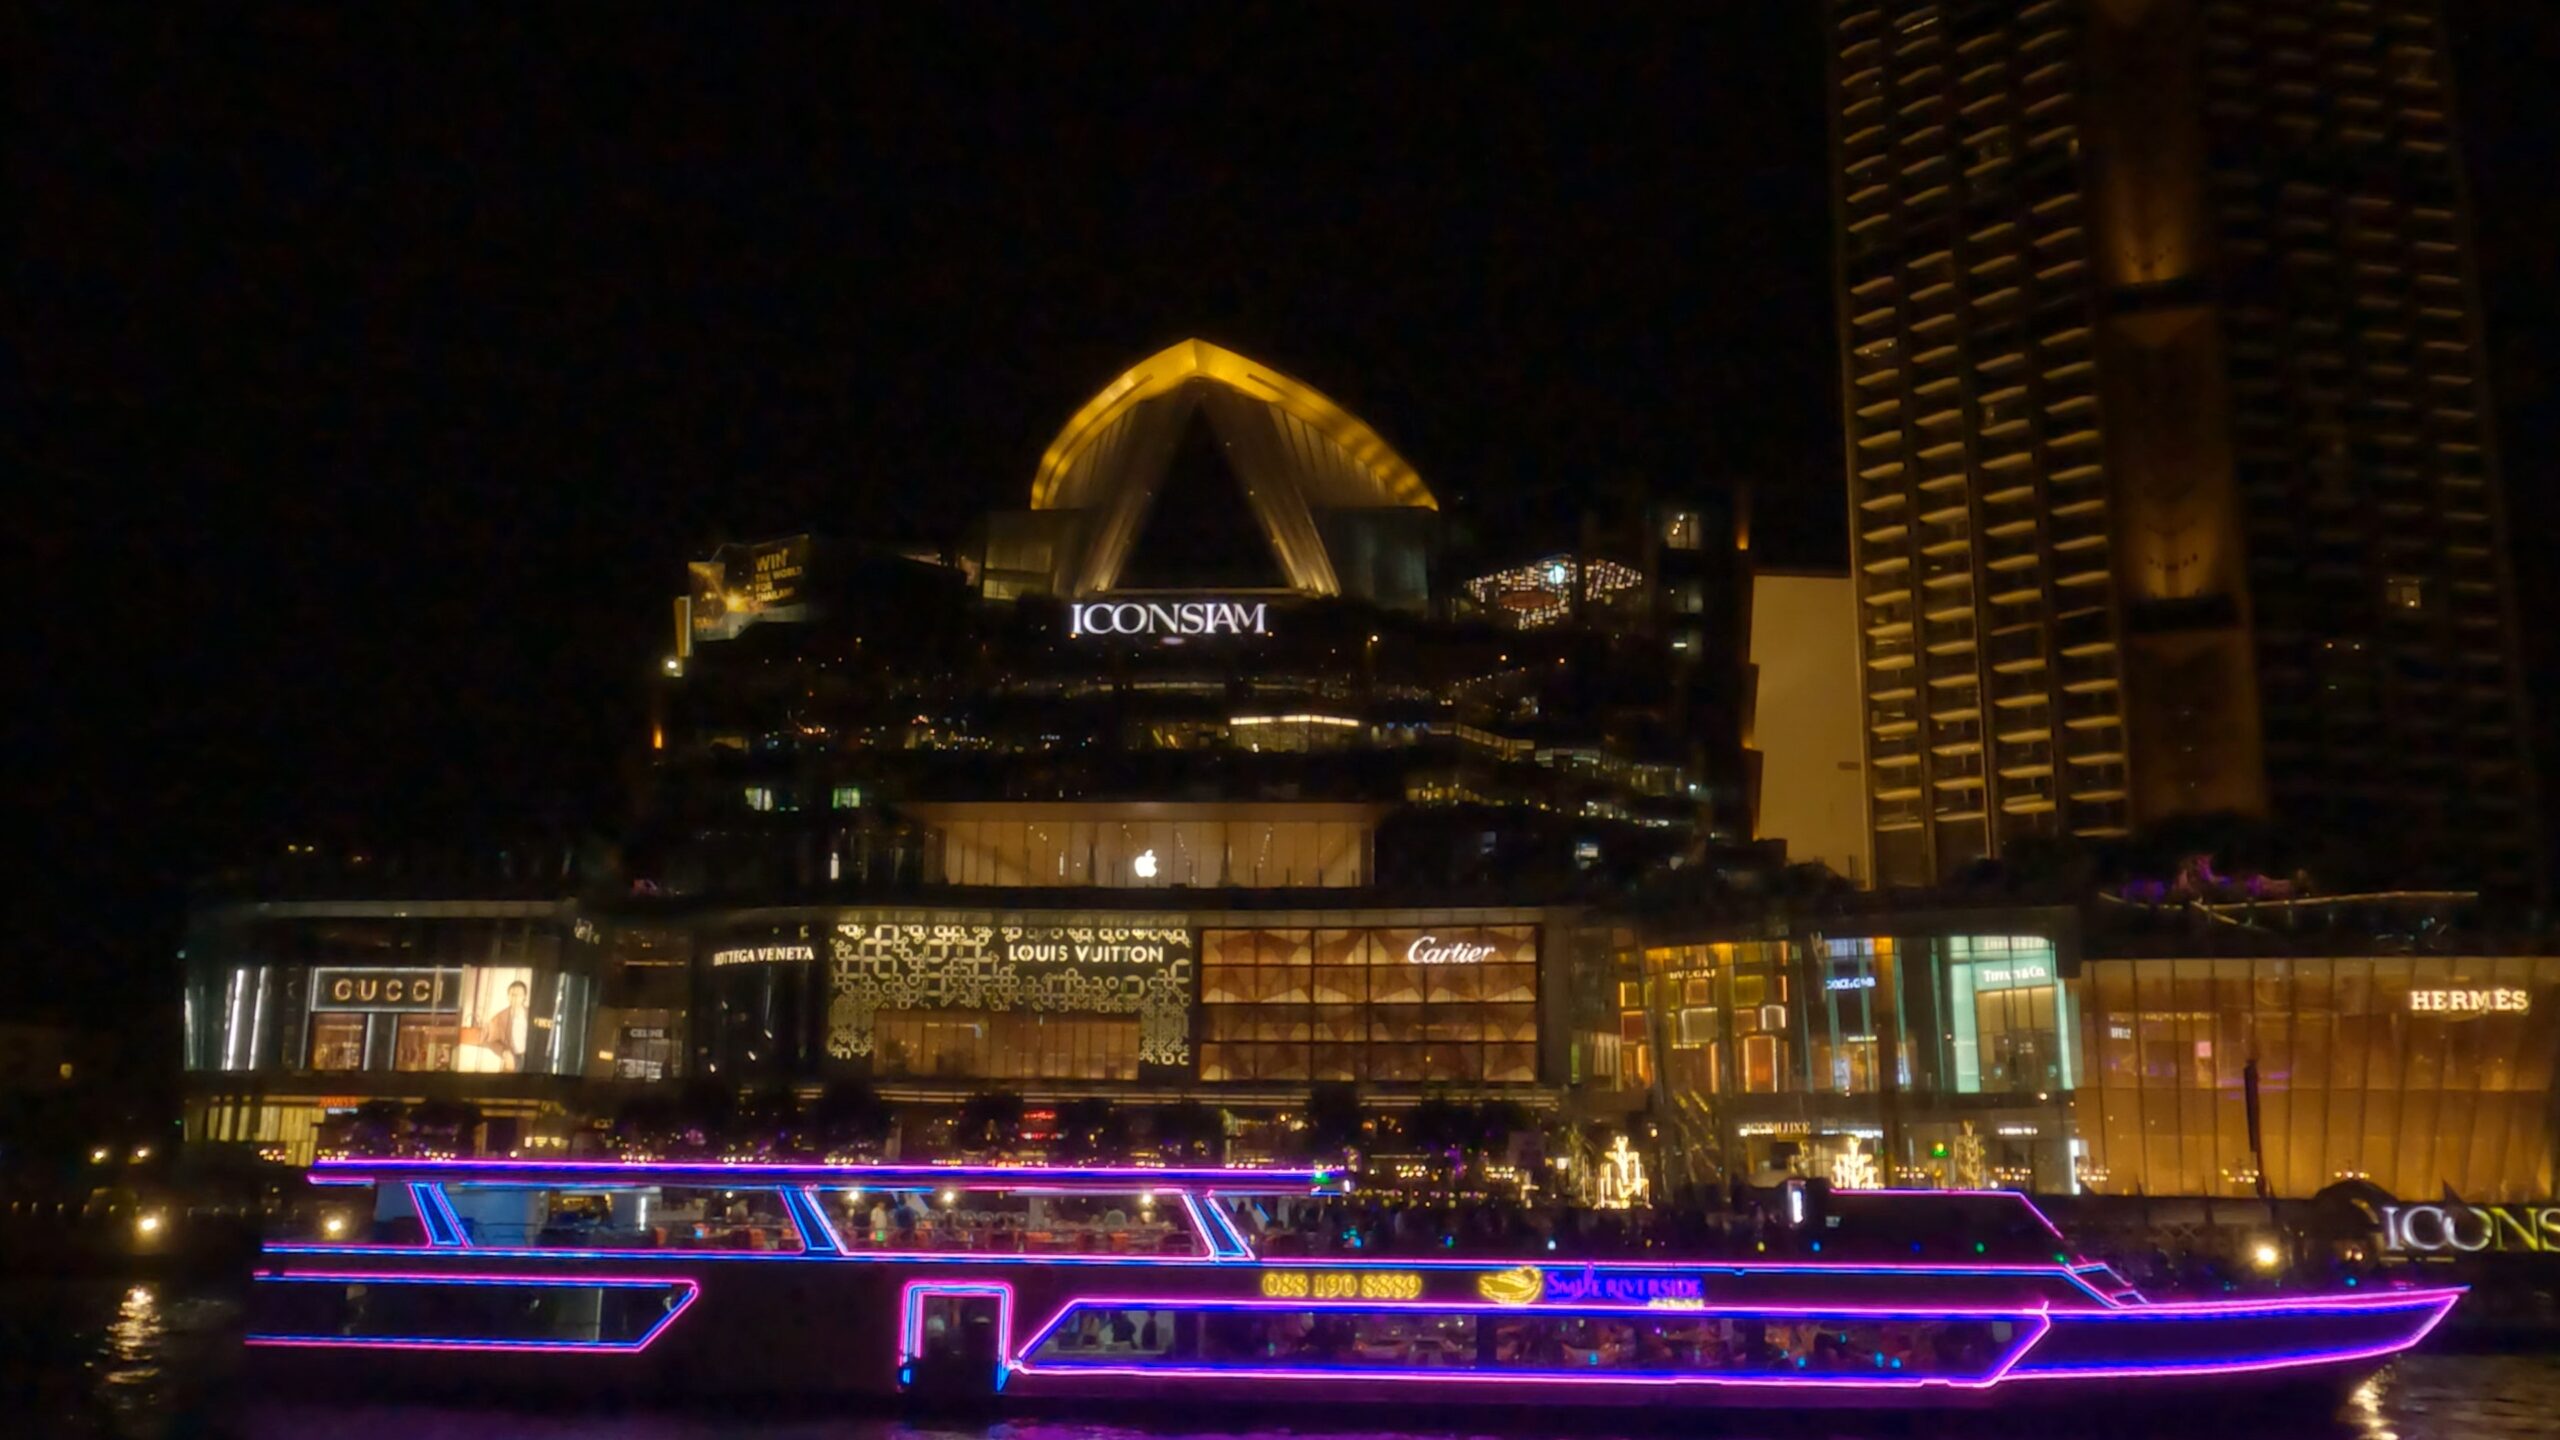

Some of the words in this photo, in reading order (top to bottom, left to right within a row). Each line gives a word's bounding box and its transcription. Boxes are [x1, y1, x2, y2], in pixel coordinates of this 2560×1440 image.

[755, 552, 787, 572] WIN
[1071, 603, 1267, 634] ICONSIAM
[713, 949, 755, 966] BOTTEGA
[757, 946, 814, 961] VENETA
[1008, 944, 1068, 962] LOUIS
[1075, 945, 1164, 963] VUITTON
[1407, 935, 1496, 964] Cartier
[334, 979, 444, 1002] GUCCI
[1262, 1272, 1309, 1298] 088
[1313, 1274, 1358, 1298] 190
